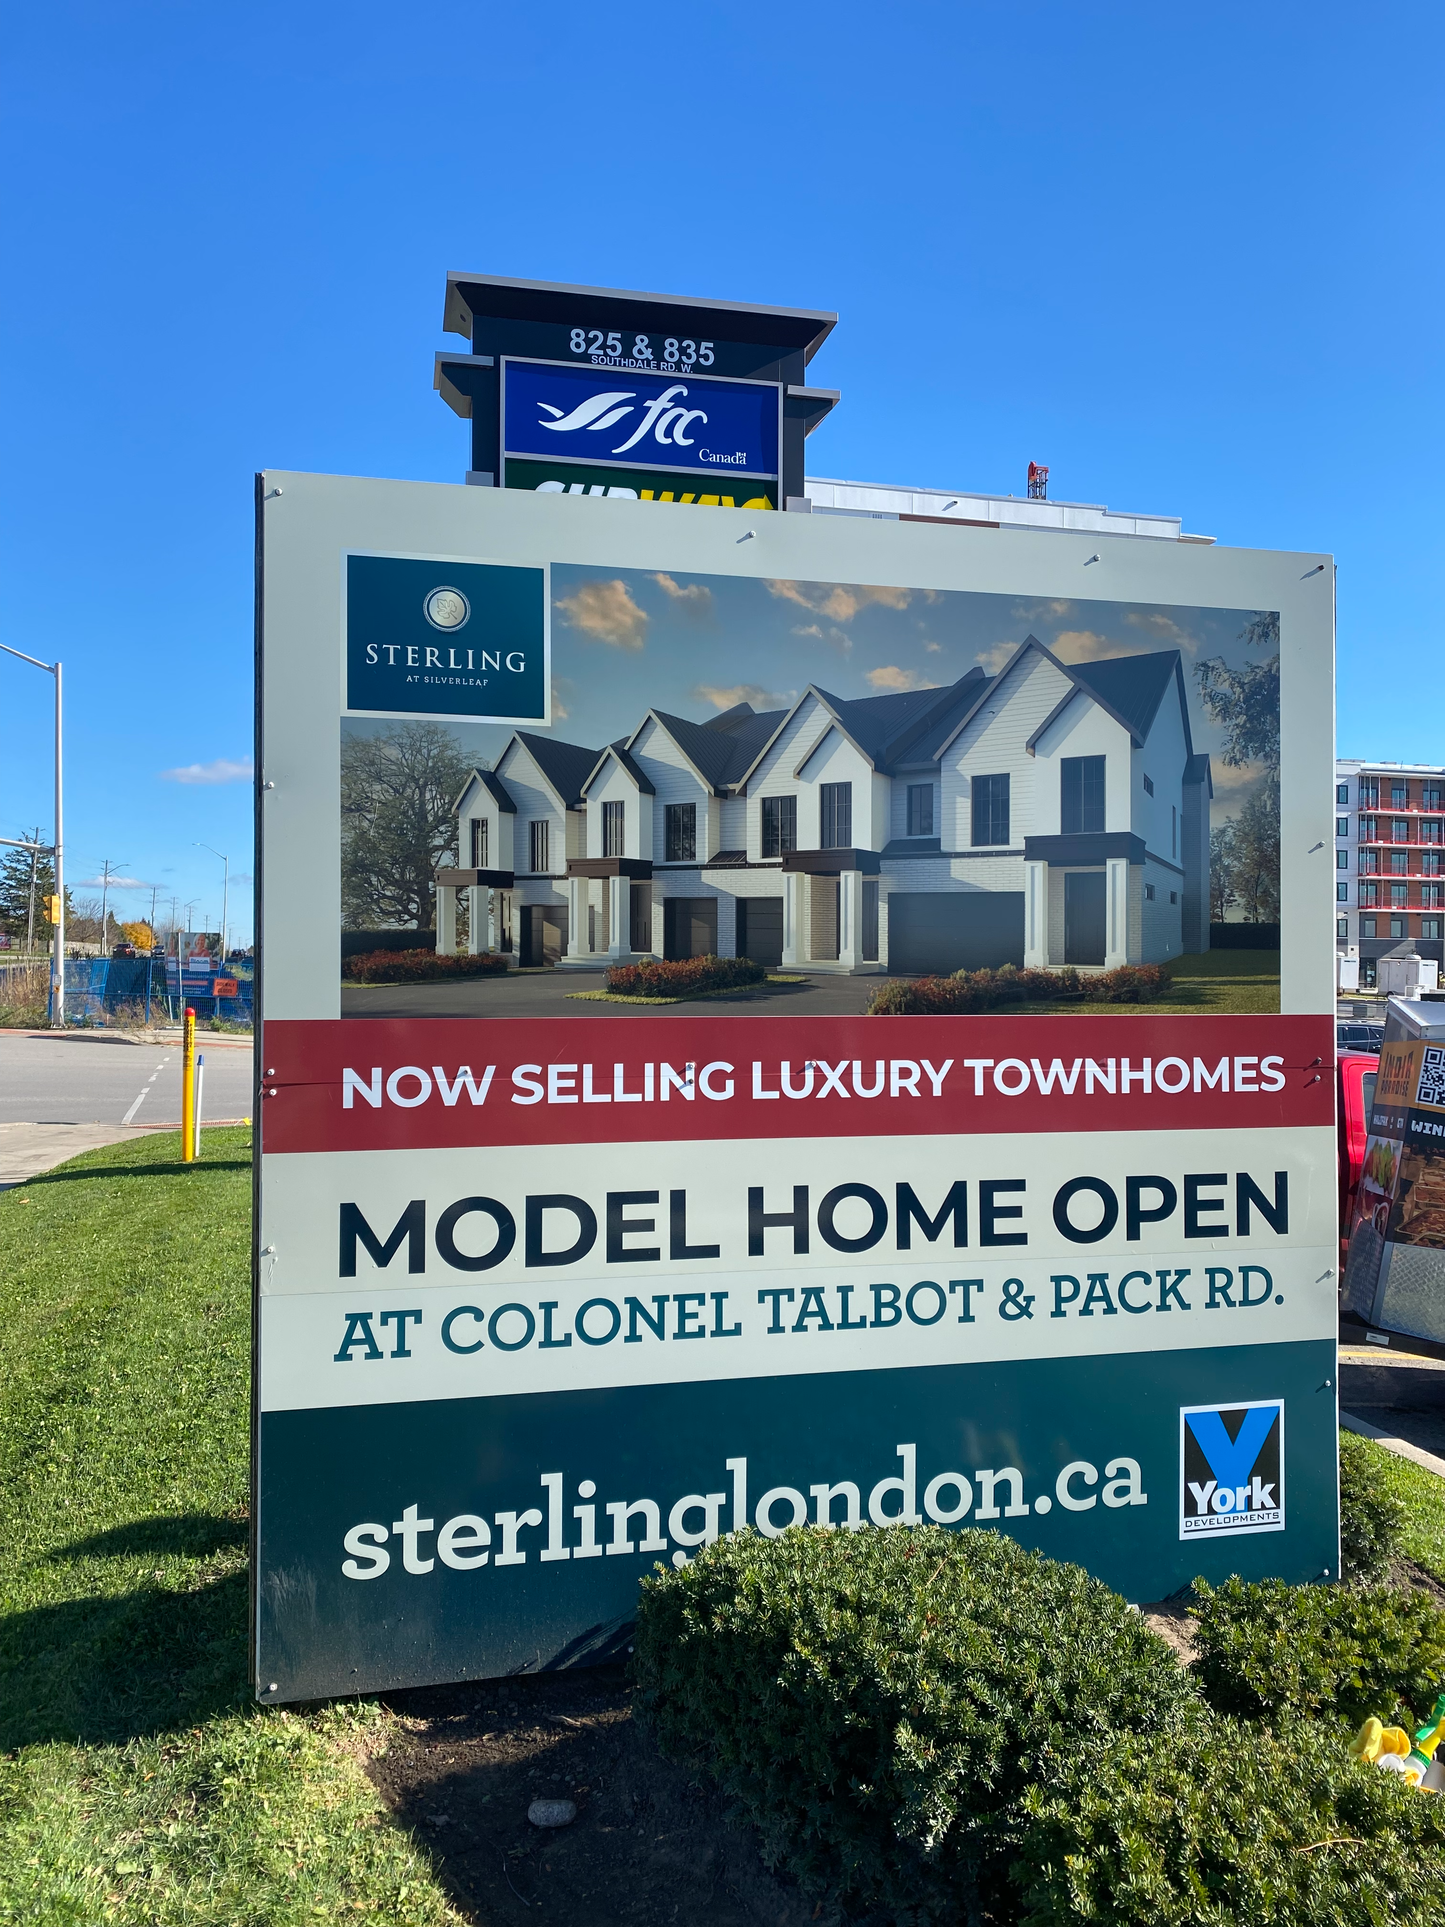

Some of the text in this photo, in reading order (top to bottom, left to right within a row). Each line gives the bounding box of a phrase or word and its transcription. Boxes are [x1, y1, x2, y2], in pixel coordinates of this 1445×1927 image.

[570, 328, 715, 366] 825 & 835
[591, 355, 694, 374] SOUTHDALE RD. W.
[611, 384, 708, 454] fcc
[698, 448, 747, 465] Canada
[365, 643, 526, 673] STERLING
[406, 675, 489, 687] AT SILVERLEAF
[1383, 1051, 1414, 1079] INDIA
[342, 1056, 1286, 1109] NOW SELLING LUXURY TOWNHOMES
[1411, 1119, 1445, 1138] WIN
[339, 1170, 1289, 1278] MODEL HOME OPEN
[333, 1265, 1285, 1363] AT COLONEL TALBOT & PACK RD.
[341, 1443, 1148, 1581] sterlinglondon.ca
[1187, 1476, 1277, 1515] York
[1185, 1512, 1280, 1528] DEVELOPMENTS
